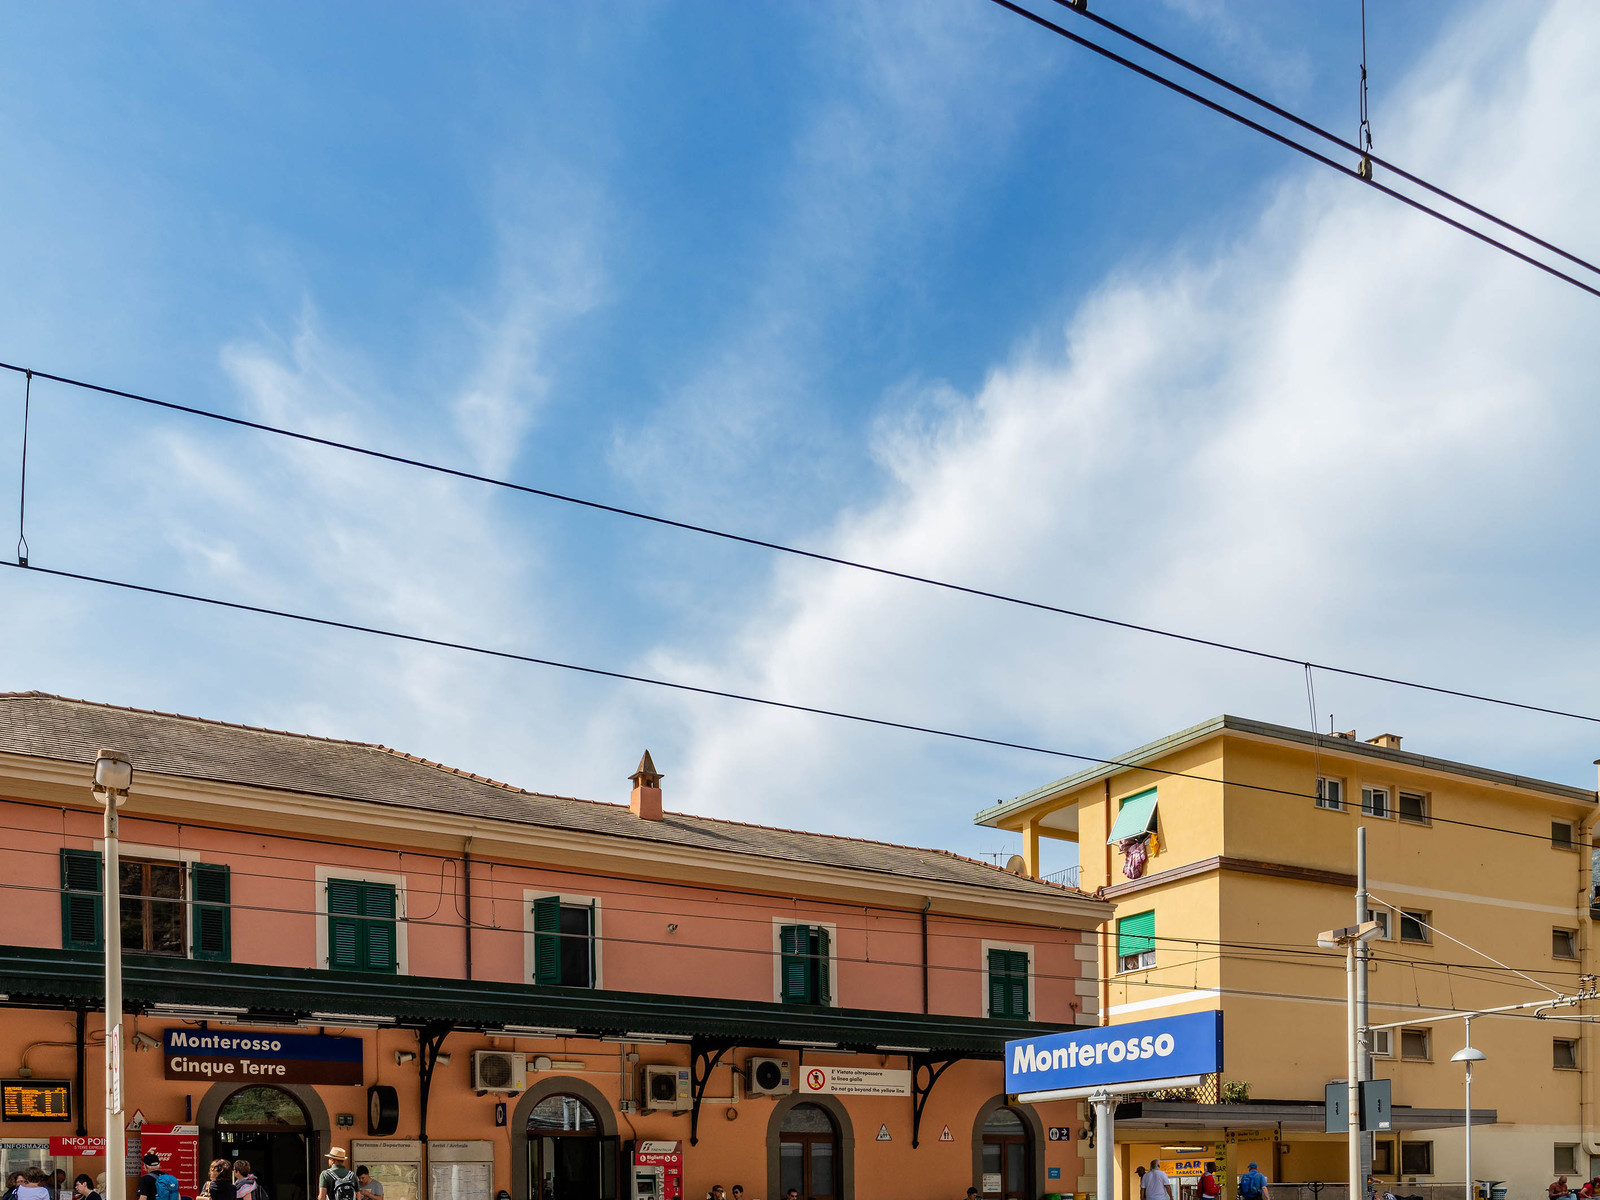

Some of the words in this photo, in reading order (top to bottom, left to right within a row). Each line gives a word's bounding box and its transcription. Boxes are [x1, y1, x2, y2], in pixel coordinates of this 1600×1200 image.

[171, 1032, 281, 1051] Monterosso
[1012, 1033, 1174, 1074] Monterosso
[171, 1057, 234, 1076] Cinque
[240, 1060, 286, 1075] Terre
[1176, 1161, 1201, 1170] BAR
